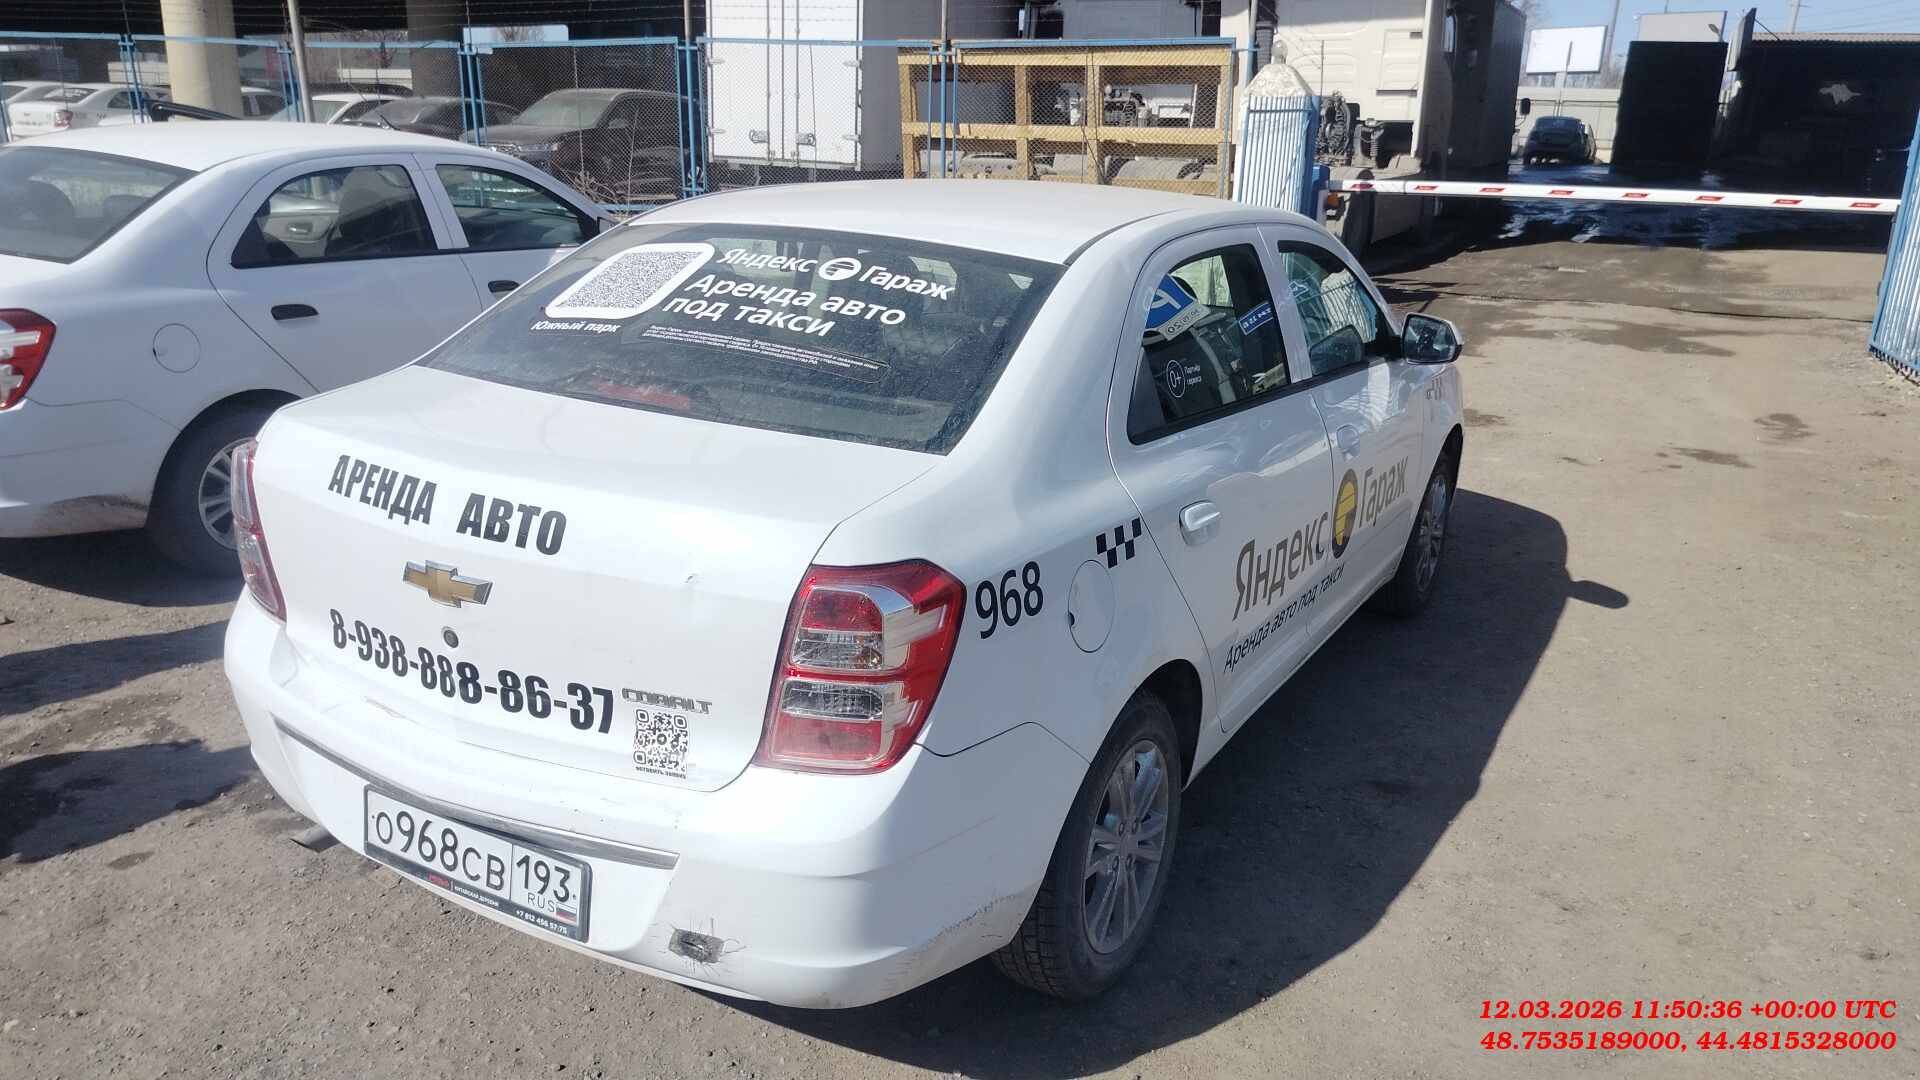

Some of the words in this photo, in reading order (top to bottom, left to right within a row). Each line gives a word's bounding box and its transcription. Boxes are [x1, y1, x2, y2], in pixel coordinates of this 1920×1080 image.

[684, 274, 817, 307] Аренда
[820, 296, 906, 325] авто
[716, 249, 819, 273] Яндекс
[859, 265, 957, 300] Гараж
[530, 320, 587, 330] Южный
[583, 323, 621, 333] парк
[662, 297, 730, 321] под
[734, 306, 836, 336] такси
[328, 454, 437, 525] АРЕНДА
[456, 493, 567, 555] АВТО
[1232, 511, 1329, 622] Яндекс
[1358, 456, 1409, 528] Гараж
[976, 561, 1044, 639] 968
[1224, 620, 1271, 673] Аренда
[1270, 600, 1297, 634] авто
[1297, 583, 1319, 611] под
[1318, 562, 1345, 594] такси
[330, 608, 614, 734] 8-938-888-86-37
[516, 854, 571, 902] 193
[527, 892, 555, 912] RUS
